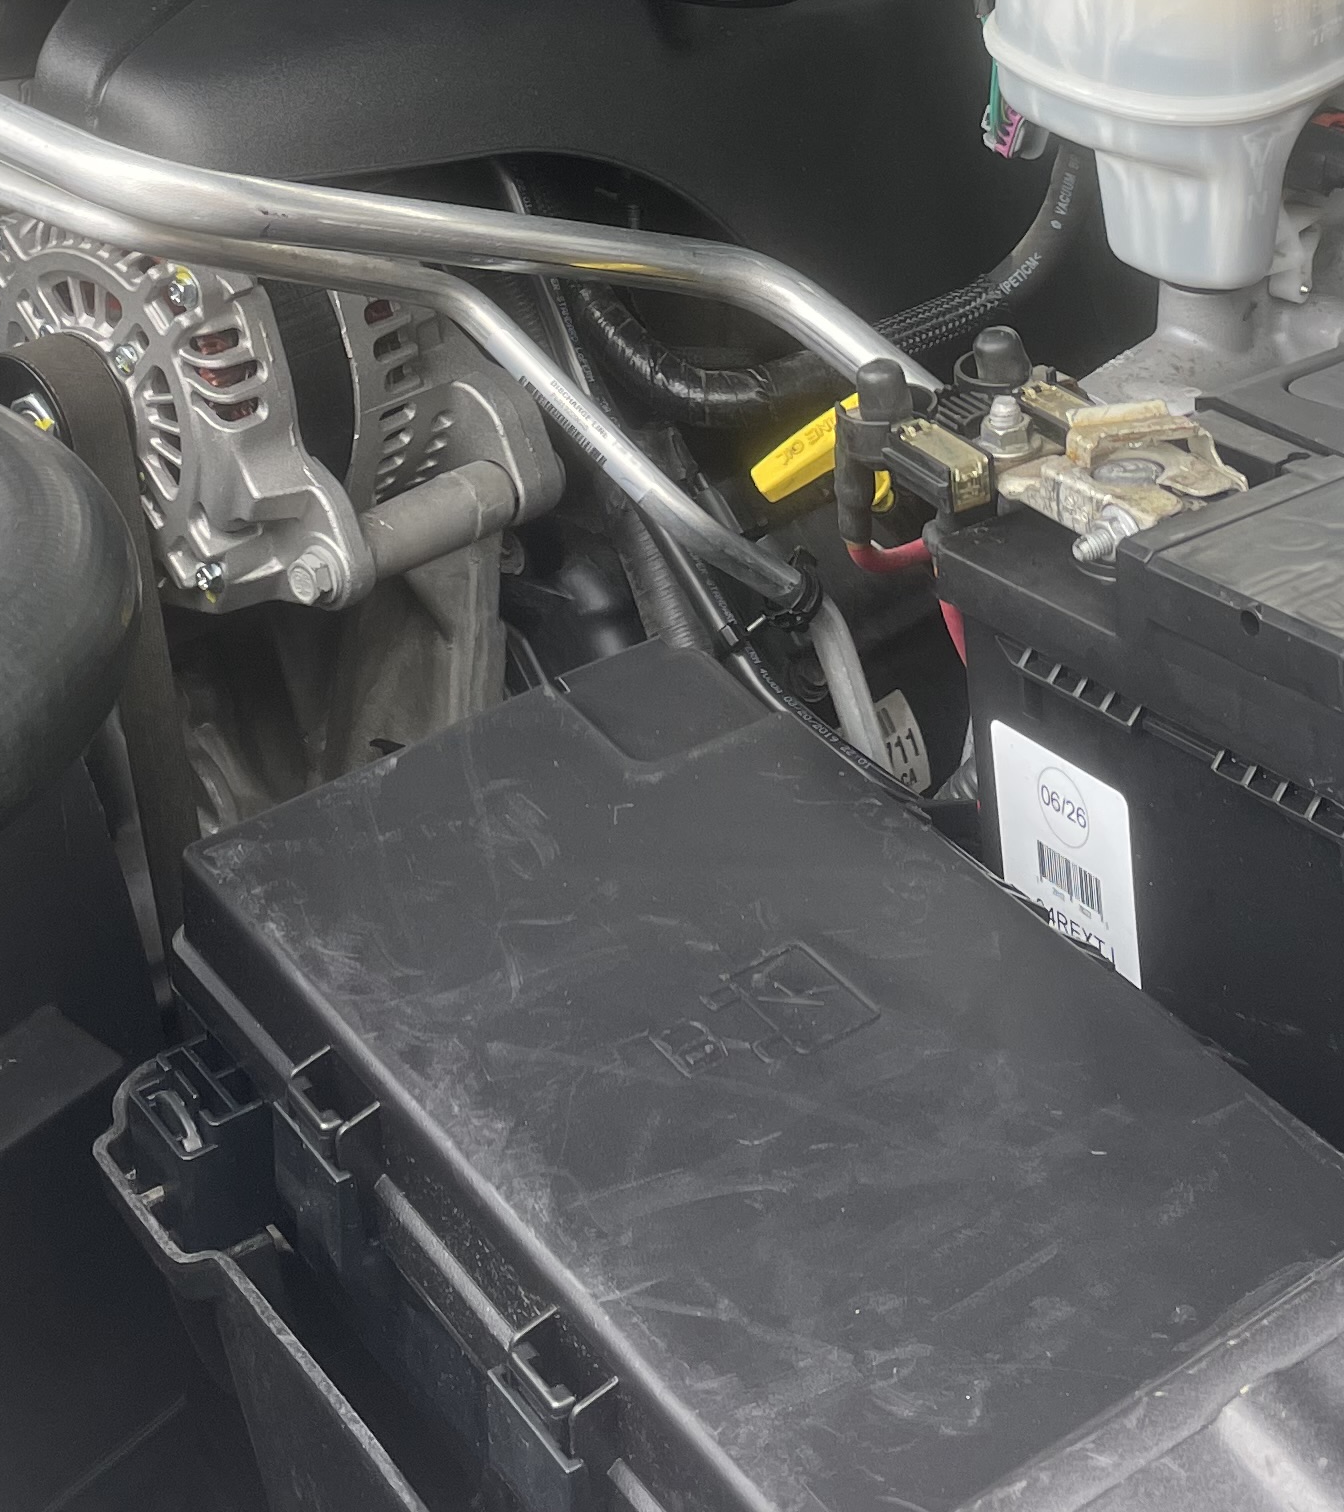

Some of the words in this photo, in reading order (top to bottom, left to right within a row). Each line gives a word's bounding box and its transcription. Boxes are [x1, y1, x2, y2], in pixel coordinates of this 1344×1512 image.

[1055, 172, 1077, 216] VACUUM
[550, 379, 591, 417] DISCHARGE
[776, 439, 805, 466] OIL
[1041, 784, 1087, 829] 06/26
